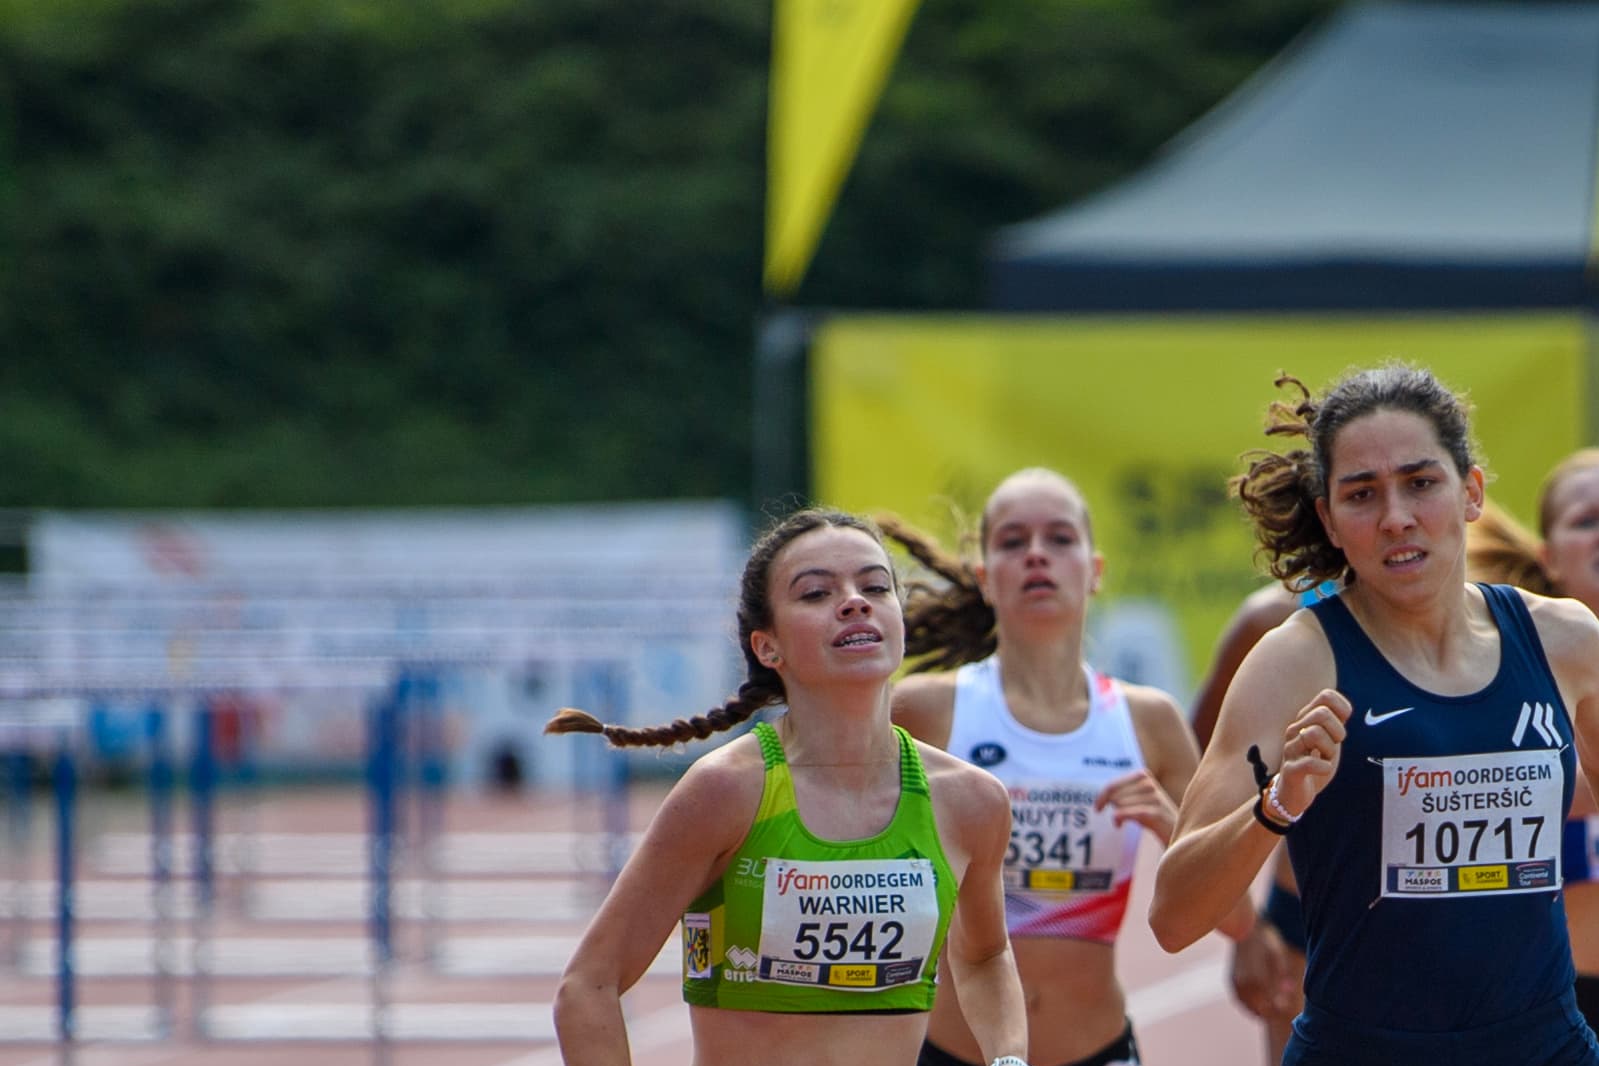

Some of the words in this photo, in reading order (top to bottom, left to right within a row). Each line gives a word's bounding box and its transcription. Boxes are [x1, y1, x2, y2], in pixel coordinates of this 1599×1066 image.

[1421, 786, 1533, 813] ŠUŠTERŠIČ
[1405, 816, 1545, 864] 10717
[798, 894, 906, 915] WARNIER
[792, 920, 905, 960] 5542
